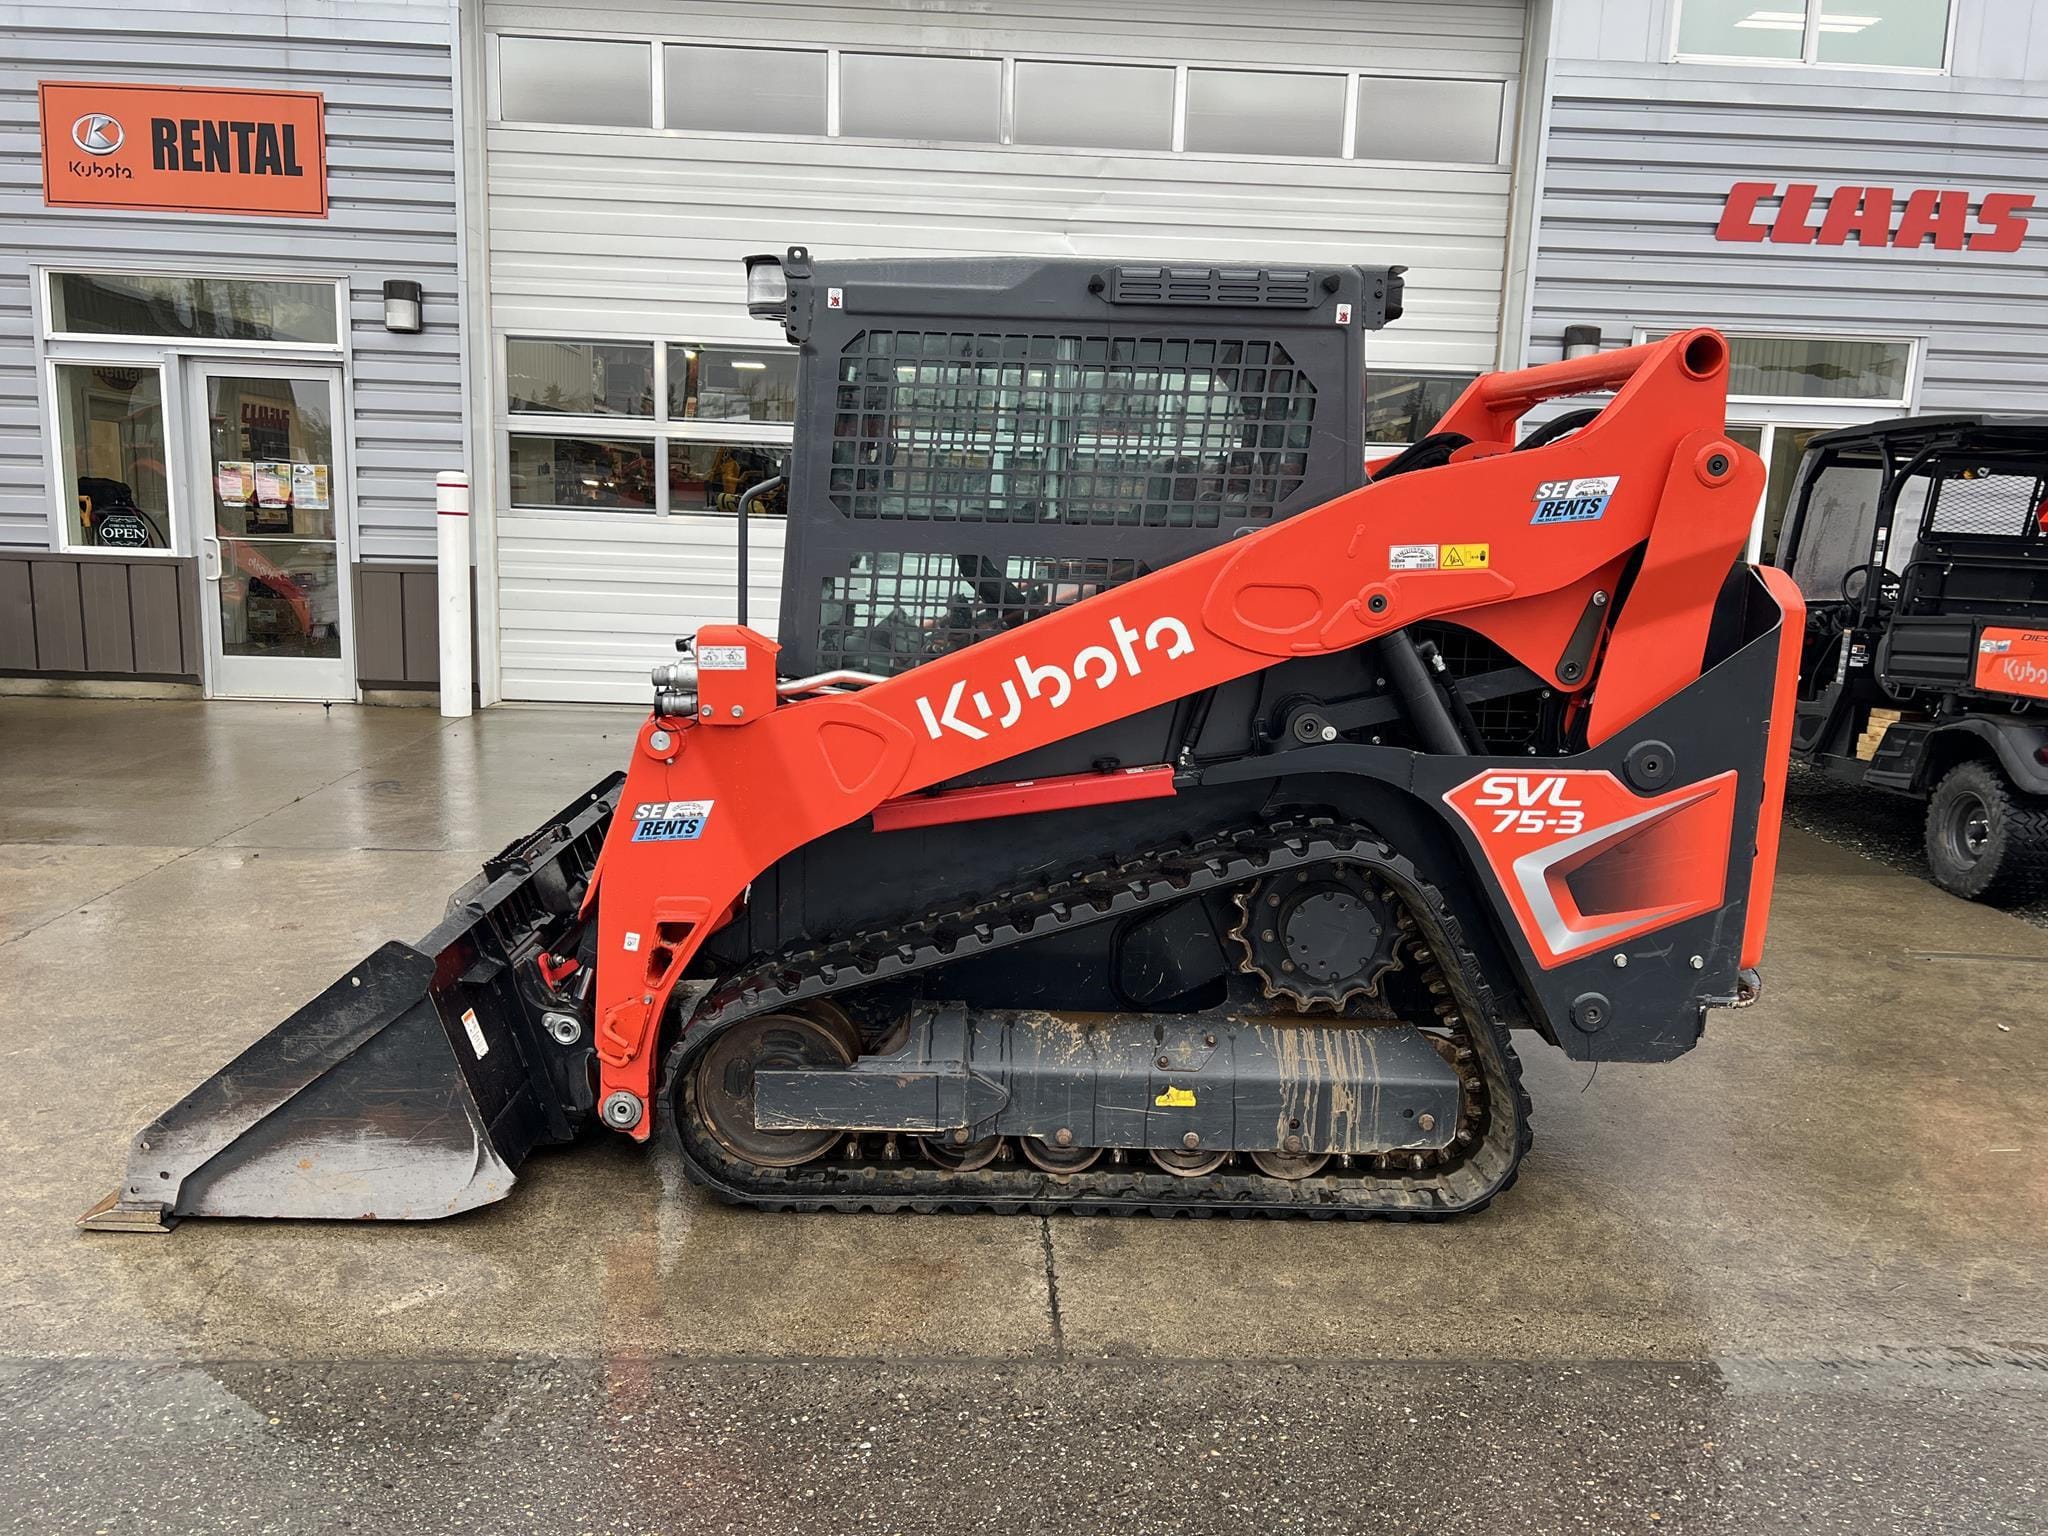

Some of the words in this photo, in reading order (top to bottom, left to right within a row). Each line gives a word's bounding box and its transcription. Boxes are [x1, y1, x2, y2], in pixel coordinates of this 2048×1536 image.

[151, 117, 304, 177] RENTAL
[69, 160, 133, 179] Kubota
[1715, 181, 2037, 253] CLAAS
[1536, 481, 1569, 499] SE
[1539, 497, 1602, 518] RENTS
[102, 527, 145, 539] OPEN
[915, 616, 1196, 740] Kubota
[1474, 776, 1583, 807] SVL
[634, 804, 666, 819] SE
[1491, 810, 1585, 834] 75-3
[640, 819, 699, 836] RENTS
